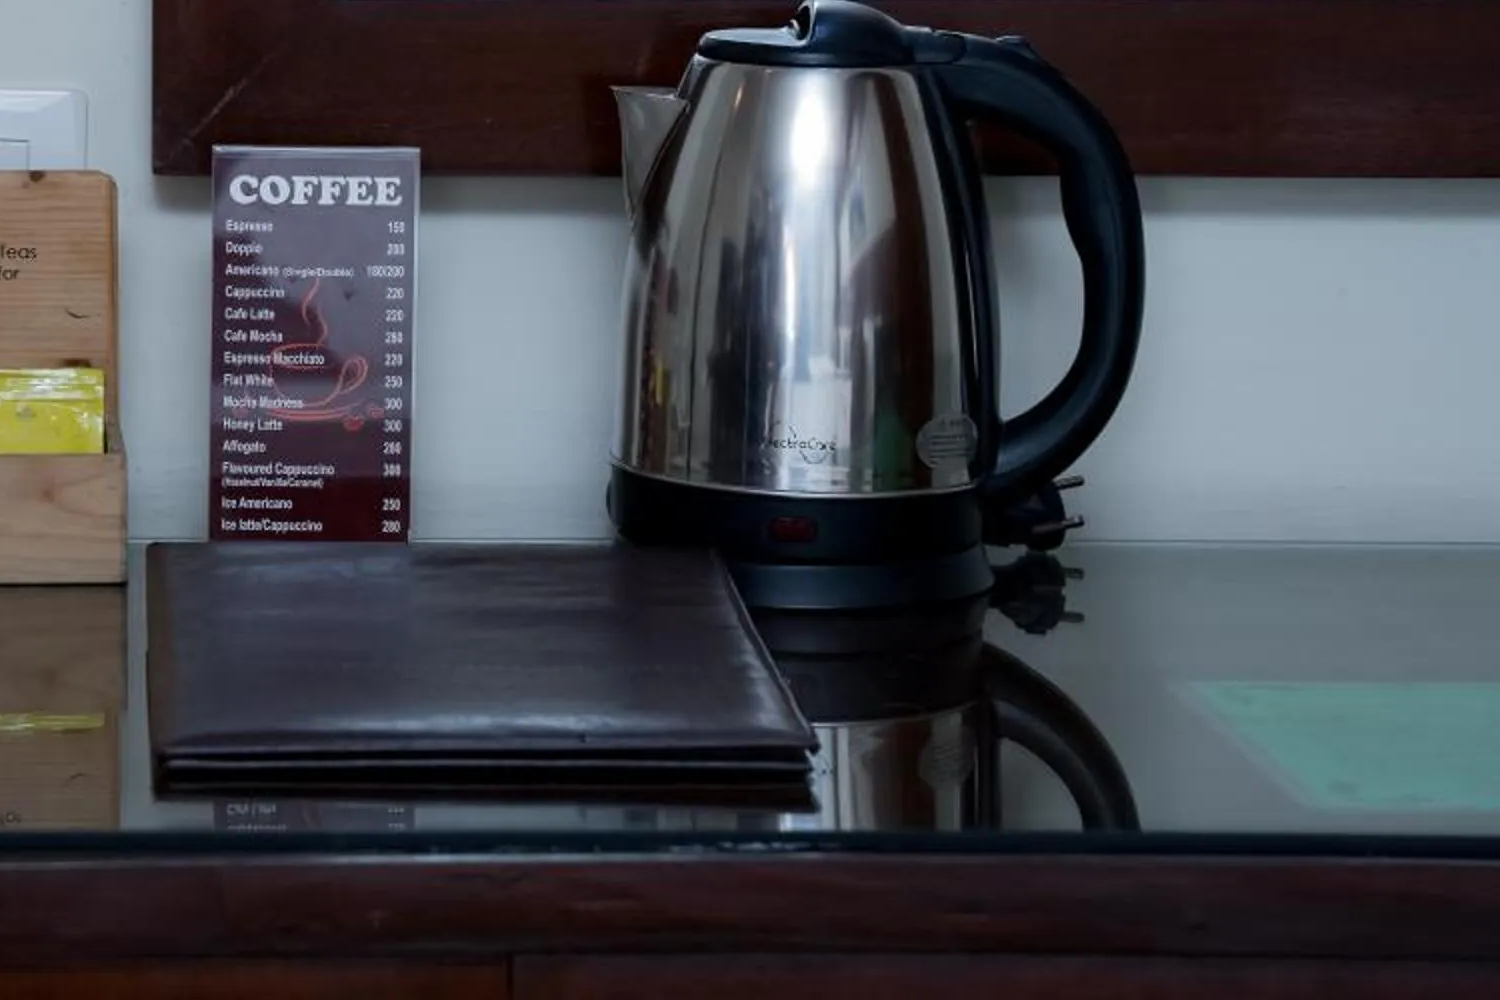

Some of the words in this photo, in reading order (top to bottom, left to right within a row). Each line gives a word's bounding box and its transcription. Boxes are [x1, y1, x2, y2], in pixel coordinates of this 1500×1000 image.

[229, 174, 402, 205] COFFEE
[225, 220, 273, 234] Espresso
[0, 245, 37, 261] Teas
[225, 242, 263, 257] Doppio
[225, 263, 279, 276] Americano
[225, 286, 285, 300] Cappuccino
[224, 307, 248, 320] Cafe
[224, 330, 247, 342] Cafe
[274, 353, 325, 365] Macchiato
[223, 374, 243, 386] Flat
[245, 374, 274, 387] White
[223, 418, 254, 432] Honey
[257, 418, 283, 431] Latte
[222, 440, 267, 455] Affogato
[222, 463, 273, 475] Flavoured
[274, 463, 335, 477] Cappuccino
[221, 497, 238, 510] Ice
[239, 496, 293, 510] Americano
[221, 519, 238, 531] Ice
